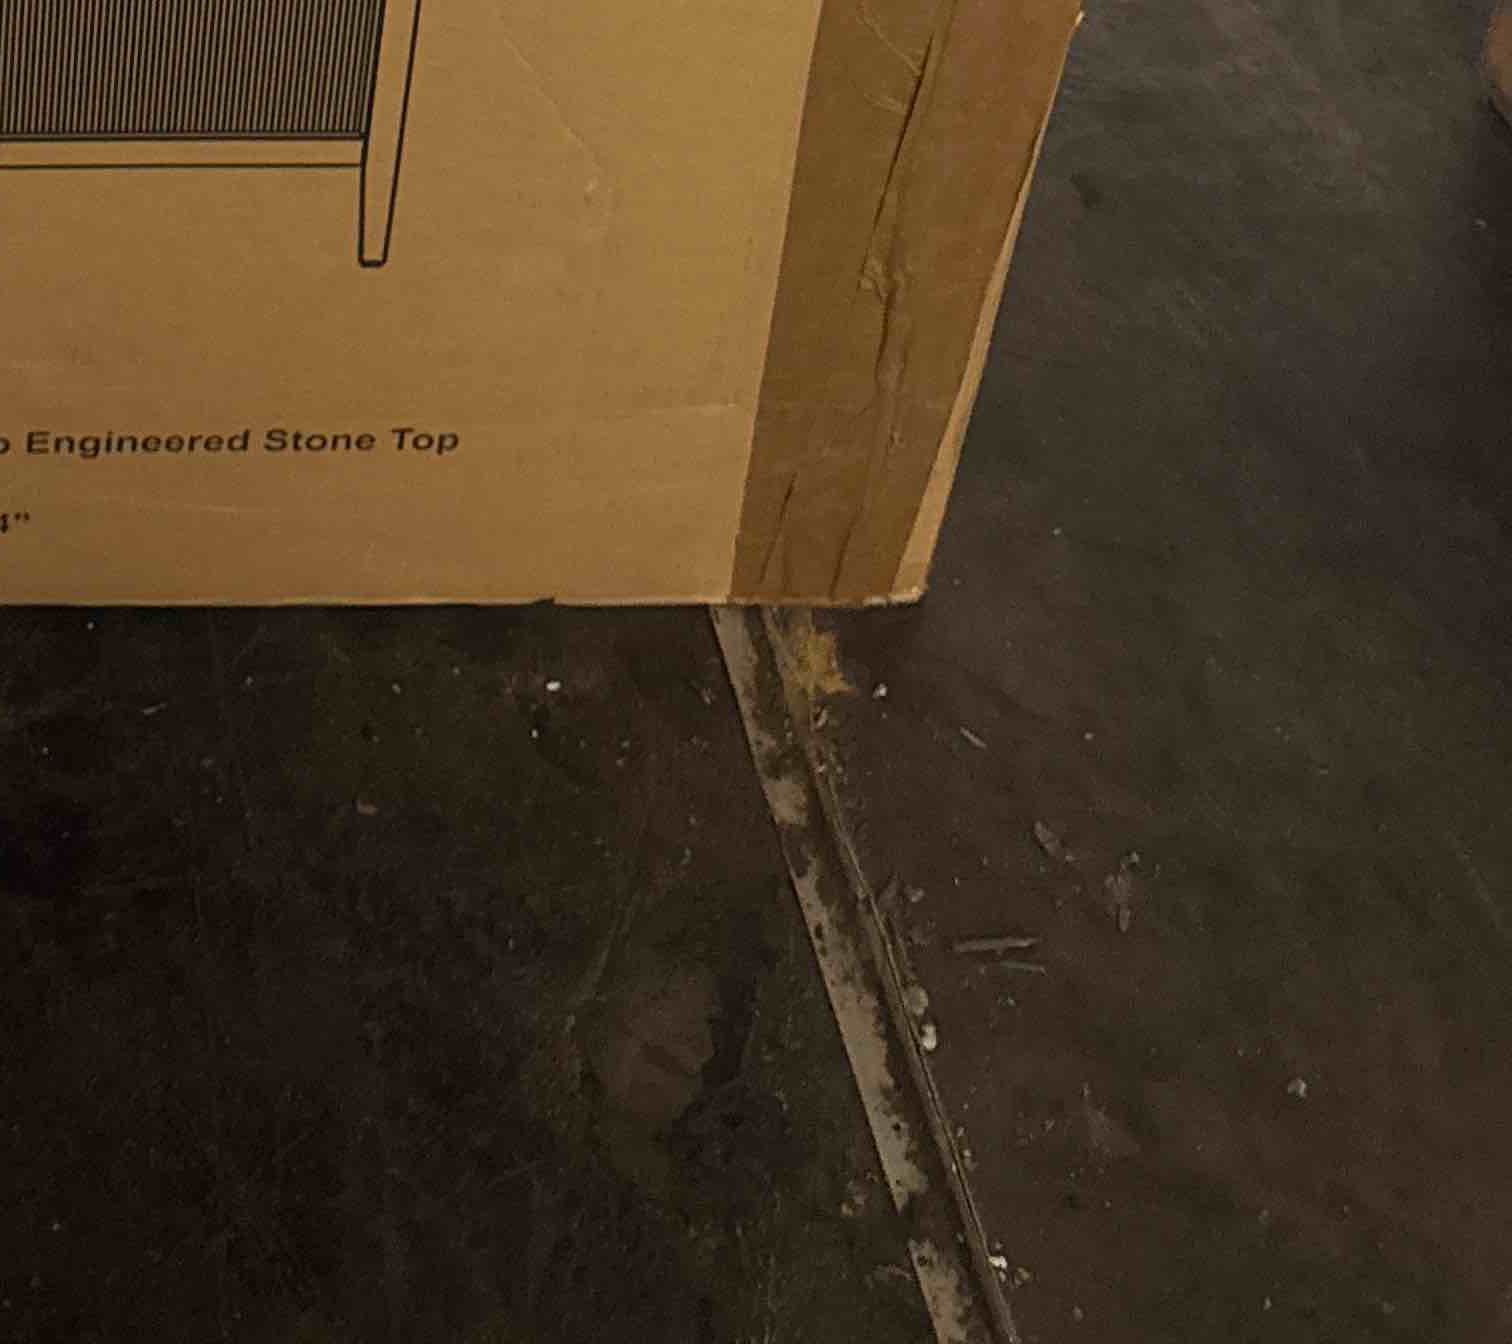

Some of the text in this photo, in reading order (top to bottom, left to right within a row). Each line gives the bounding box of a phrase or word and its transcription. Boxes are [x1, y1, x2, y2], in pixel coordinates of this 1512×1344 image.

[26, 429, 252, 460] Engineered
[263, 427, 376, 453] Stone
[390, 426, 460, 456] Top
